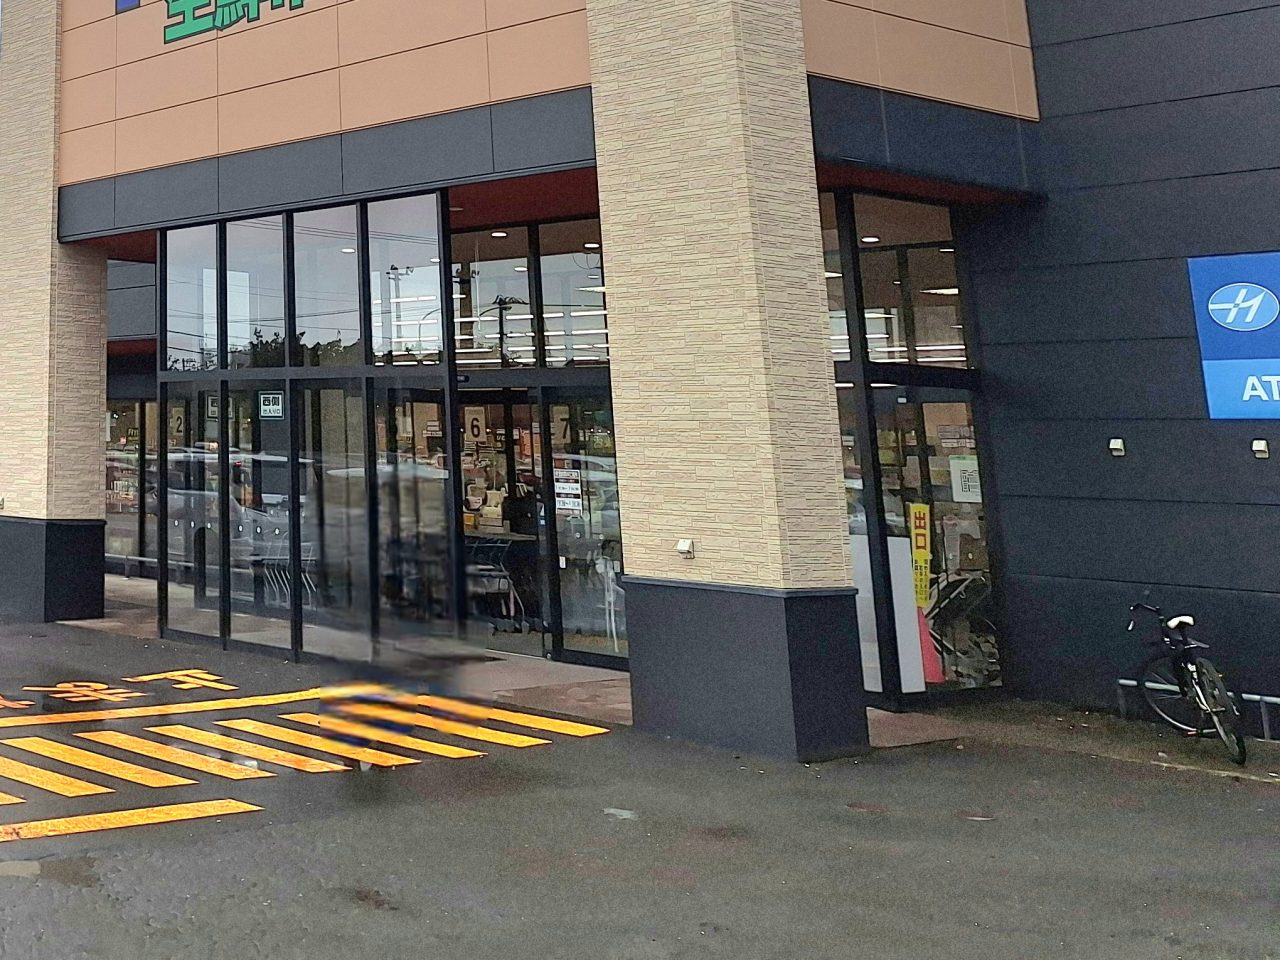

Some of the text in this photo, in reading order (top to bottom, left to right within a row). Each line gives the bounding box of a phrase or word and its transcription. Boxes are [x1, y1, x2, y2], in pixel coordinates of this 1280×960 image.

[176, 416, 183, 434] 2
[470, 417, 480, 438] 6
[559, 417, 570, 439] 7
[914, 510, 927, 551] 出口
